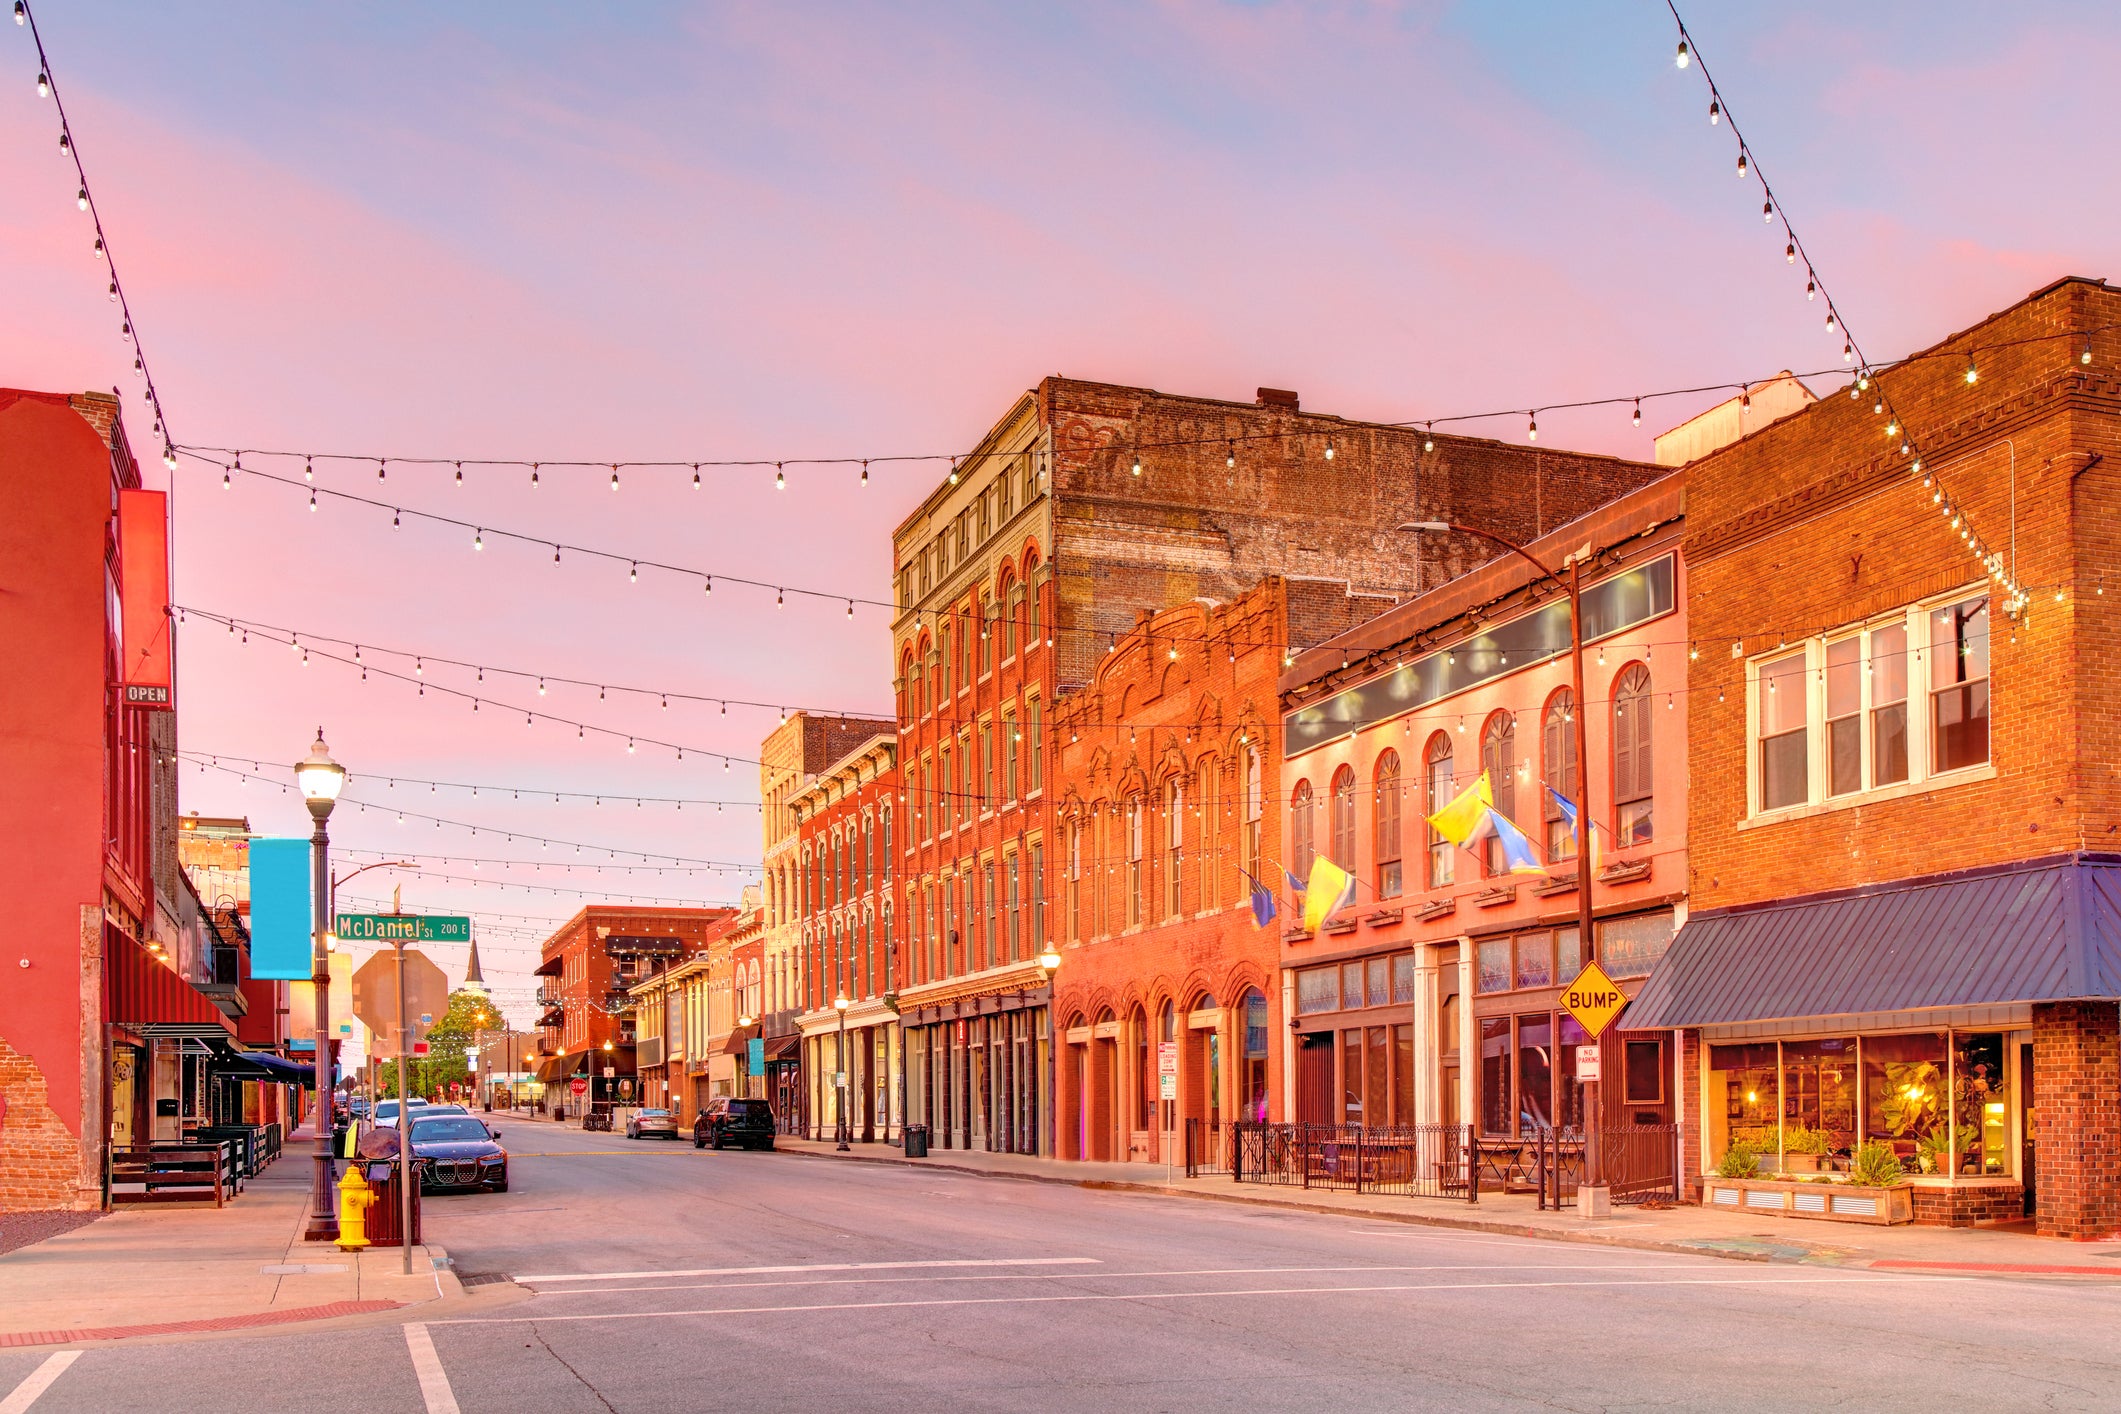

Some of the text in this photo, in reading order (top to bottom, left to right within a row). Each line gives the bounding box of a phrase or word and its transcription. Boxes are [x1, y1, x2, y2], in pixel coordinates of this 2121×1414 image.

[129, 686, 166, 701] OPEN
[340, 917, 466, 938] McDaniel St 200 E
[1570, 992, 1618, 1008] BUMP
